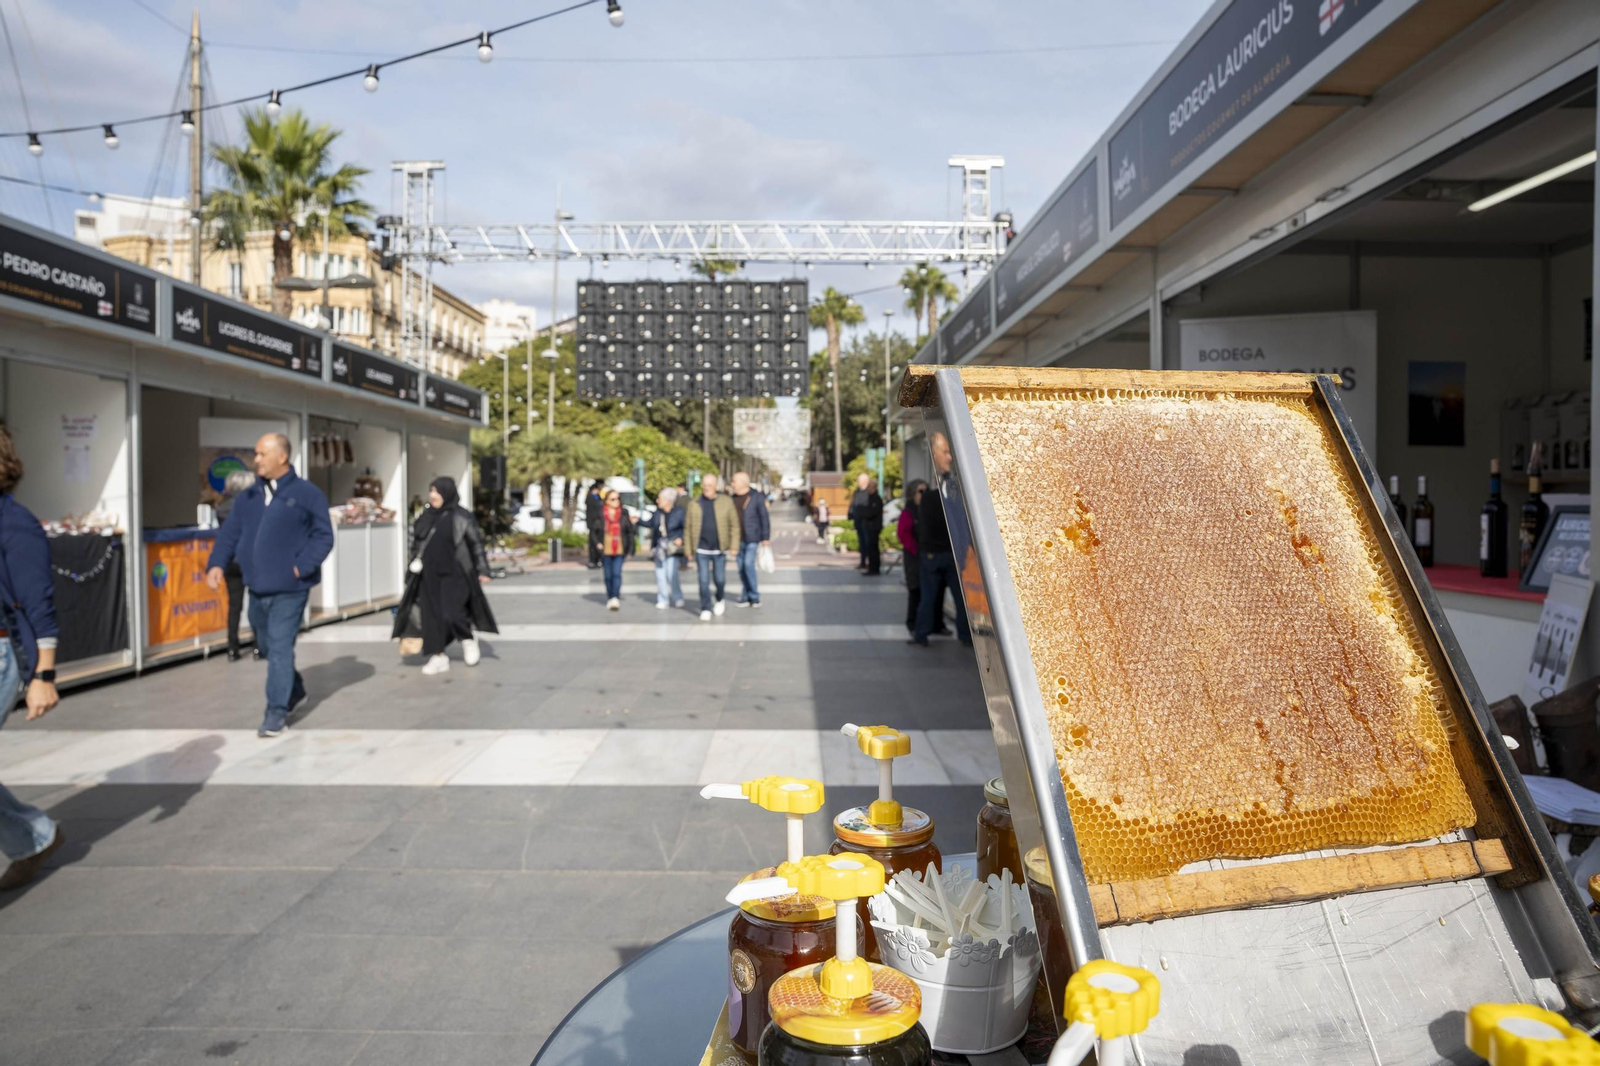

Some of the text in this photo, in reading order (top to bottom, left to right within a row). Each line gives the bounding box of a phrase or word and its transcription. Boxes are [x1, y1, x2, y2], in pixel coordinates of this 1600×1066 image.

[1168, 1, 1295, 136] BODEGA LAURICIUS
[3, 251, 106, 298] PEDRO CASTAÑO
[1198, 347, 1266, 363] BODEGA
